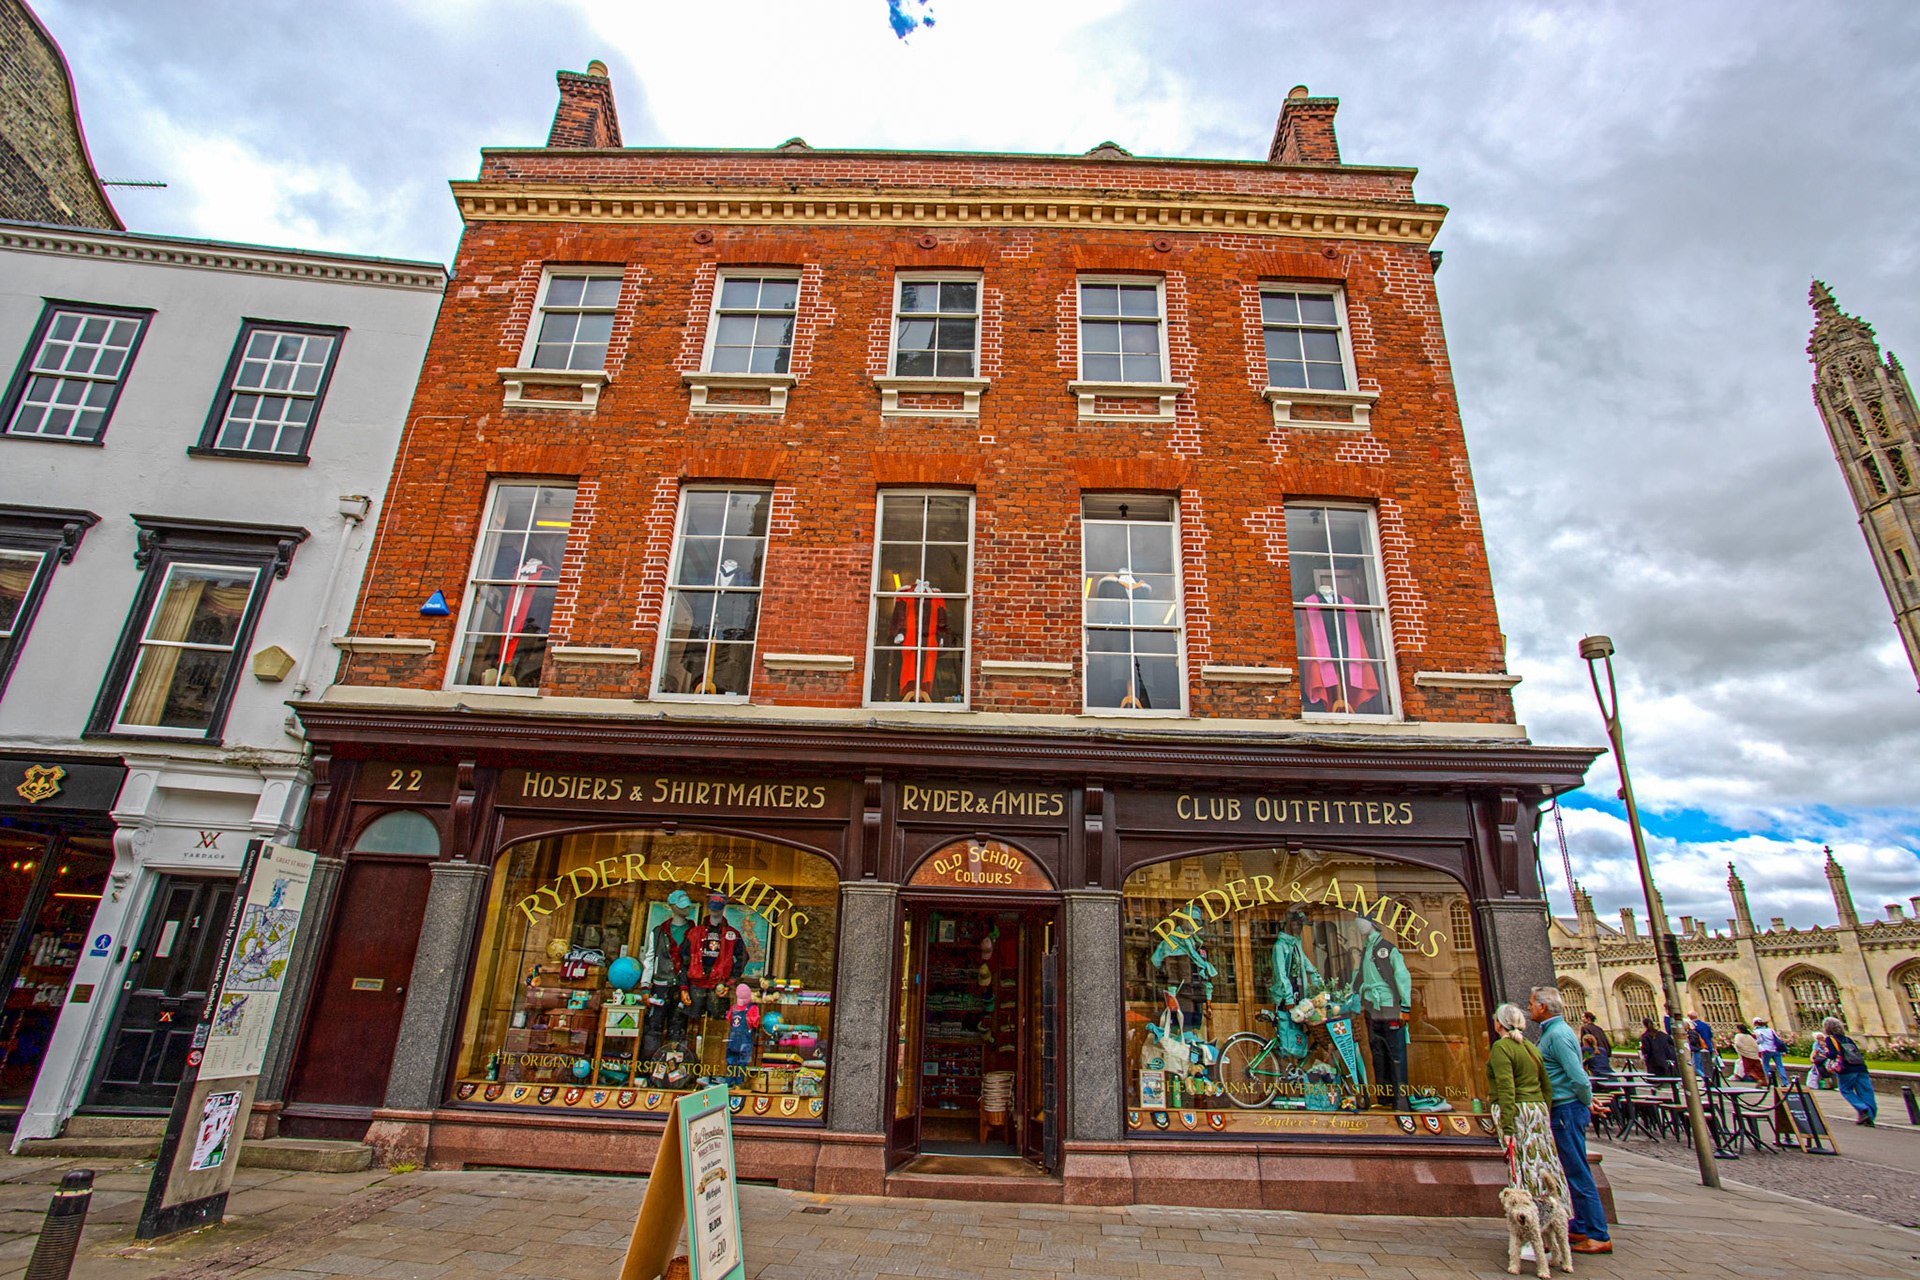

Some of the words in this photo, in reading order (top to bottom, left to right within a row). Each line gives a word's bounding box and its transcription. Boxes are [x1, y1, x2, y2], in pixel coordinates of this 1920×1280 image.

[387, 769, 424, 792] 22
[522, 772, 623, 800] HOSIERS
[629, 785, 643, 801] &
[652, 778, 826, 808] SHIRTMAKERS
[1176, 795, 1242, 822] CLUB
[1255, 796, 1413, 825] OUTFITTERS
[933, 853, 962, 875] OLD
[969, 846, 1024, 875] SCHOOL
[954, 869, 1013, 885] COLOURS
[516, 853, 650, 928] RYDER
[658, 860, 682, 882] &
[686, 857, 810, 940] AMIES
[192, 915, 201, 928] 1
[229, 896, 244, 928] Supported
[1152, 874, 1283, 952] RYDER
[1289, 881, 1312, 904] &
[1319, 877, 1447, 958] AMIES
[225, 928, 235, 938] by
[220, 938, 232, 958] Grand
[214, 958, 226, 982] Arcade
[203, 982, 219, 1019] Cambridge
[488, 1052, 516, 1065] THE
[520, 1054, 585, 1069] ORIGINAL
[590, 1058, 675, 1074] UNIVERSITY
[679, 1062, 721, 1076] STORE
[726, 1065, 767, 1078] SINCE
[1157, 1080, 1186, 1093] THE
[1191, 1081, 1258, 1094] ORIGINAL
[1262, 1082, 1346, 1096] UNIVERSITY
[1352, 1083, 1395, 1096] STORE
[1400, 1084, 1437, 1097] SINCE
[1445, 1086, 1470, 1097] 1864
[1254, 1115, 1303, 1131] Ryder
[1323, 1116, 1370, 1131] Amies
